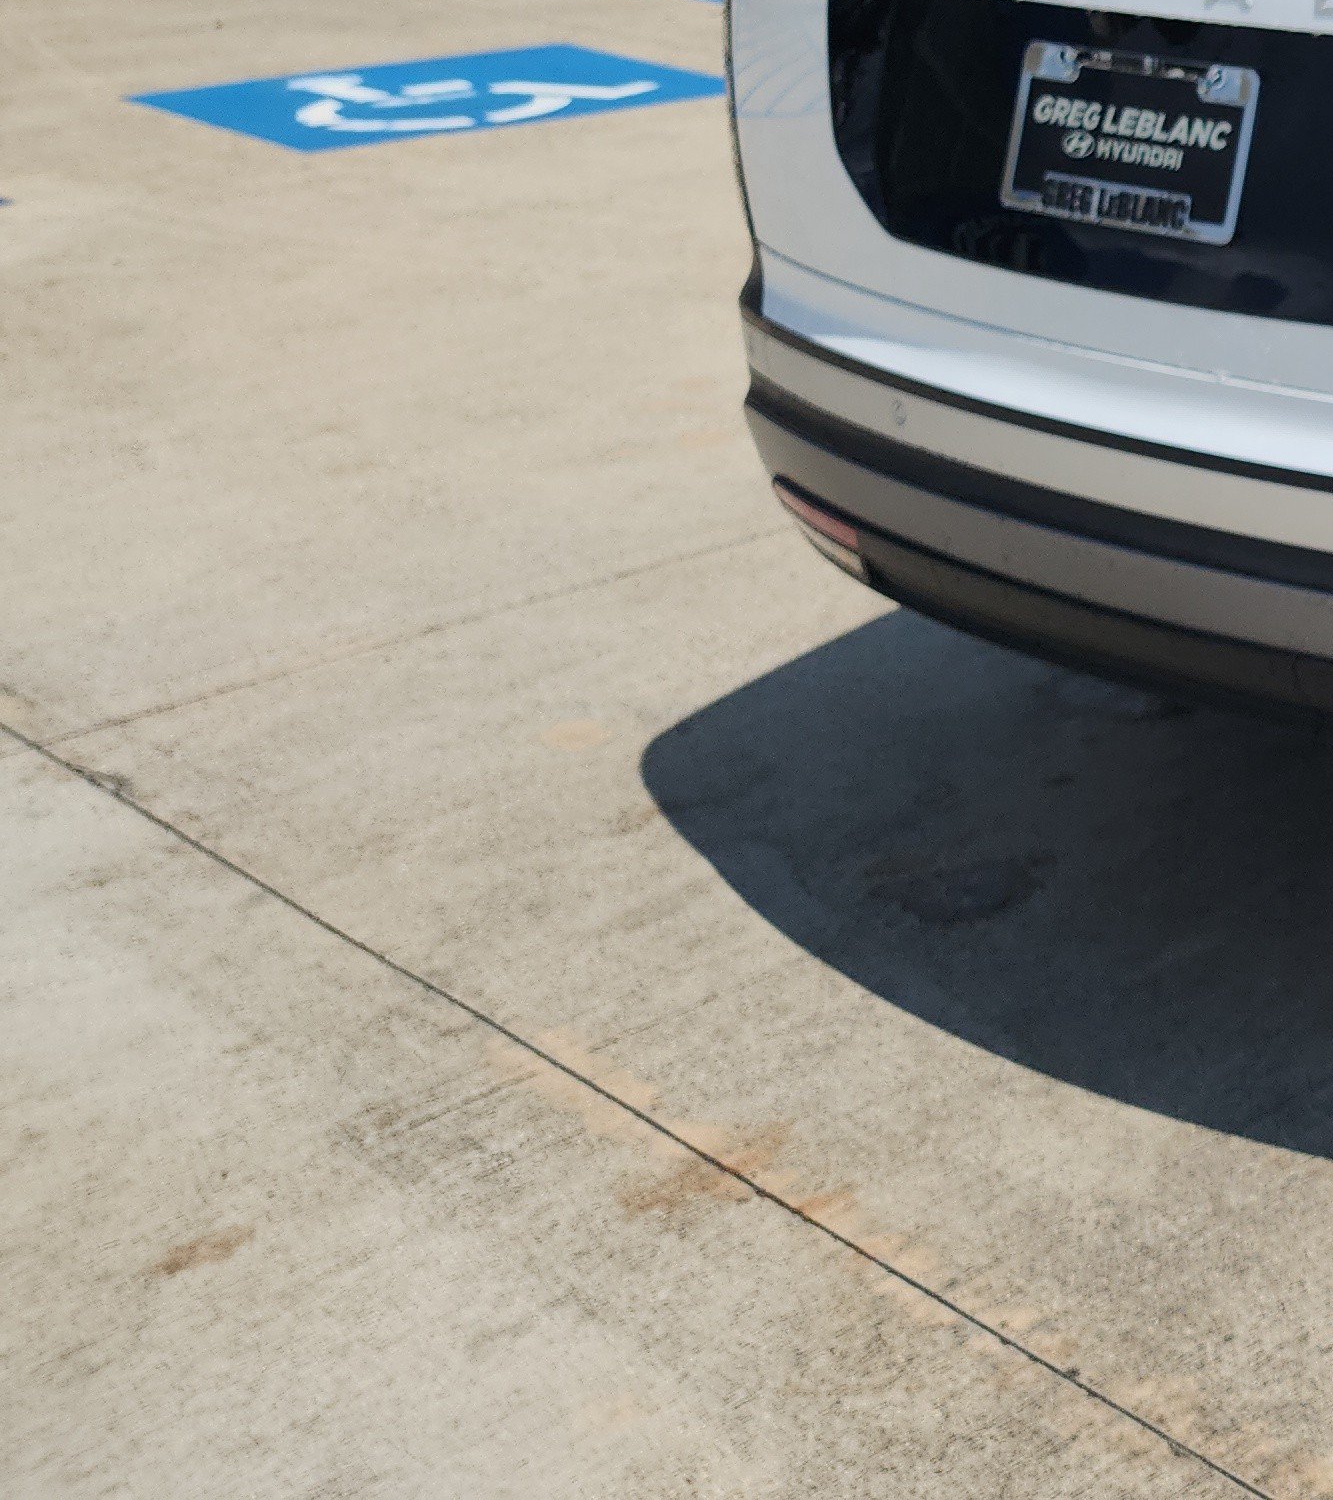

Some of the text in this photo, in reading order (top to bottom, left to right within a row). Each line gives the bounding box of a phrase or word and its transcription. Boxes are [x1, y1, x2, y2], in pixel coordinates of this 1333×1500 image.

[1033, 94, 1232, 151] GREG LEBLANC
[1096, 137, 1184, 172] HYUNDAI
